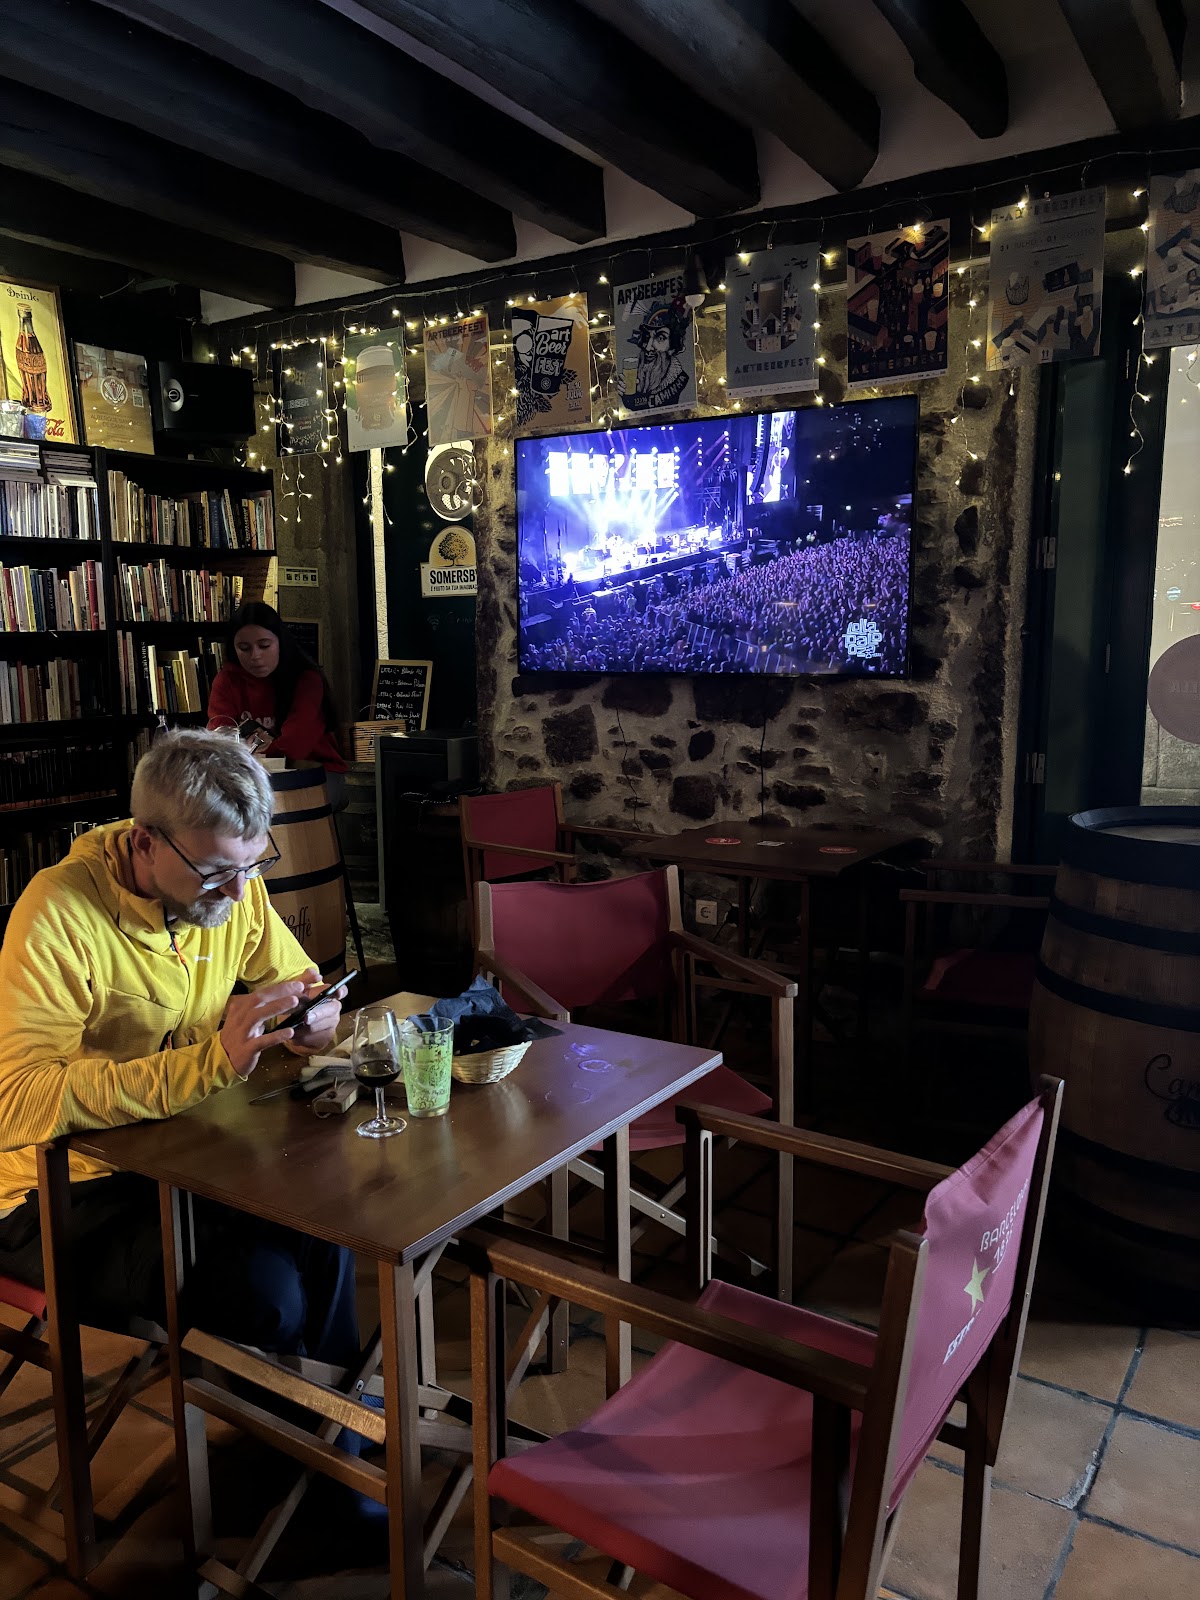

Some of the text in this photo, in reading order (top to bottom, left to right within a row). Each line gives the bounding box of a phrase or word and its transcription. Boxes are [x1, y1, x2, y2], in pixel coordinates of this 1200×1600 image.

[617, 275, 685, 305] ARTBEERFES
[427, 320, 484, 341] ARTBEERFEST
[551, 328, 571, 342] art
[535, 332, 567, 355] Beer
[45, 418, 65, 437] ola
[429, 569, 477, 584] SOMERSB
